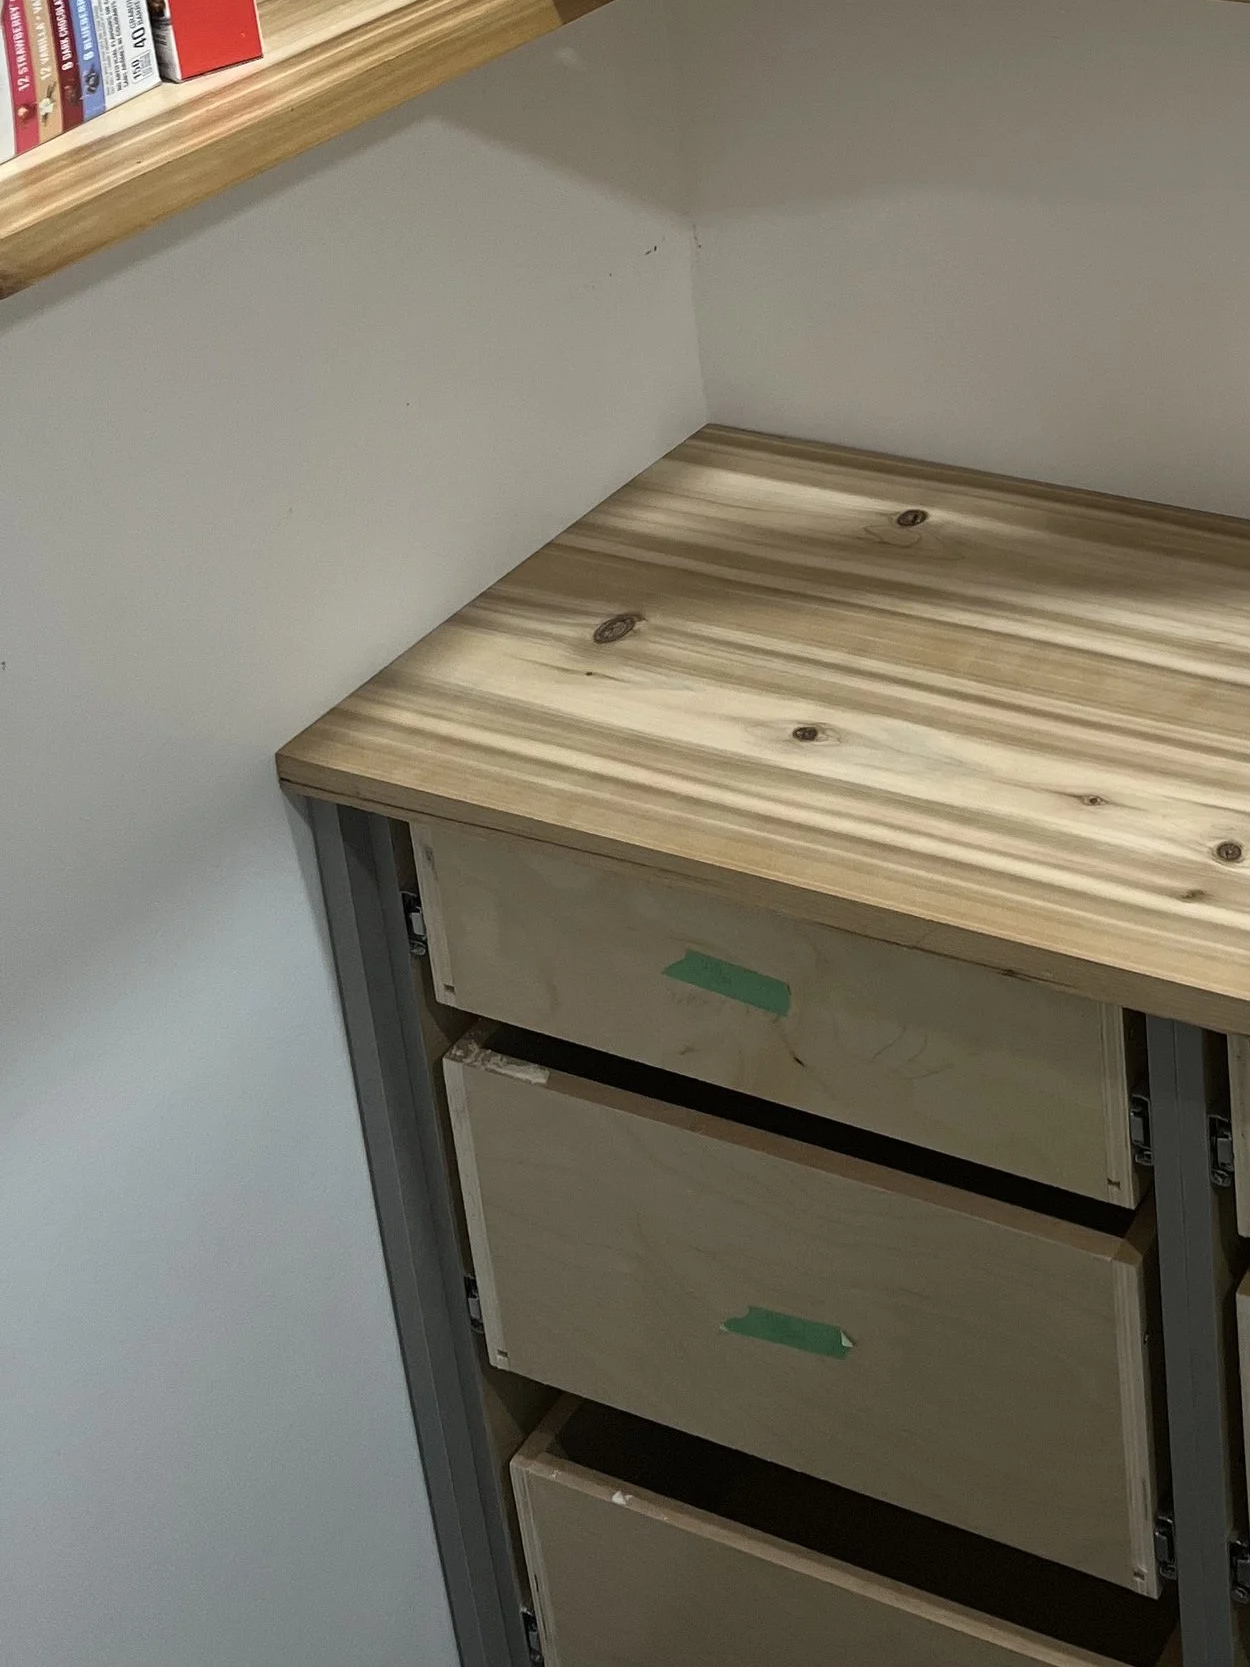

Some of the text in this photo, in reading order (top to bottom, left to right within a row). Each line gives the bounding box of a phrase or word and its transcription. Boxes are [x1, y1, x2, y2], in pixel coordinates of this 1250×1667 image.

[131, 25, 147, 49] 40
[57, 37, 72, 60] DARK
[39, 66, 52, 79] 12
[16, 76, 30, 91] 12
